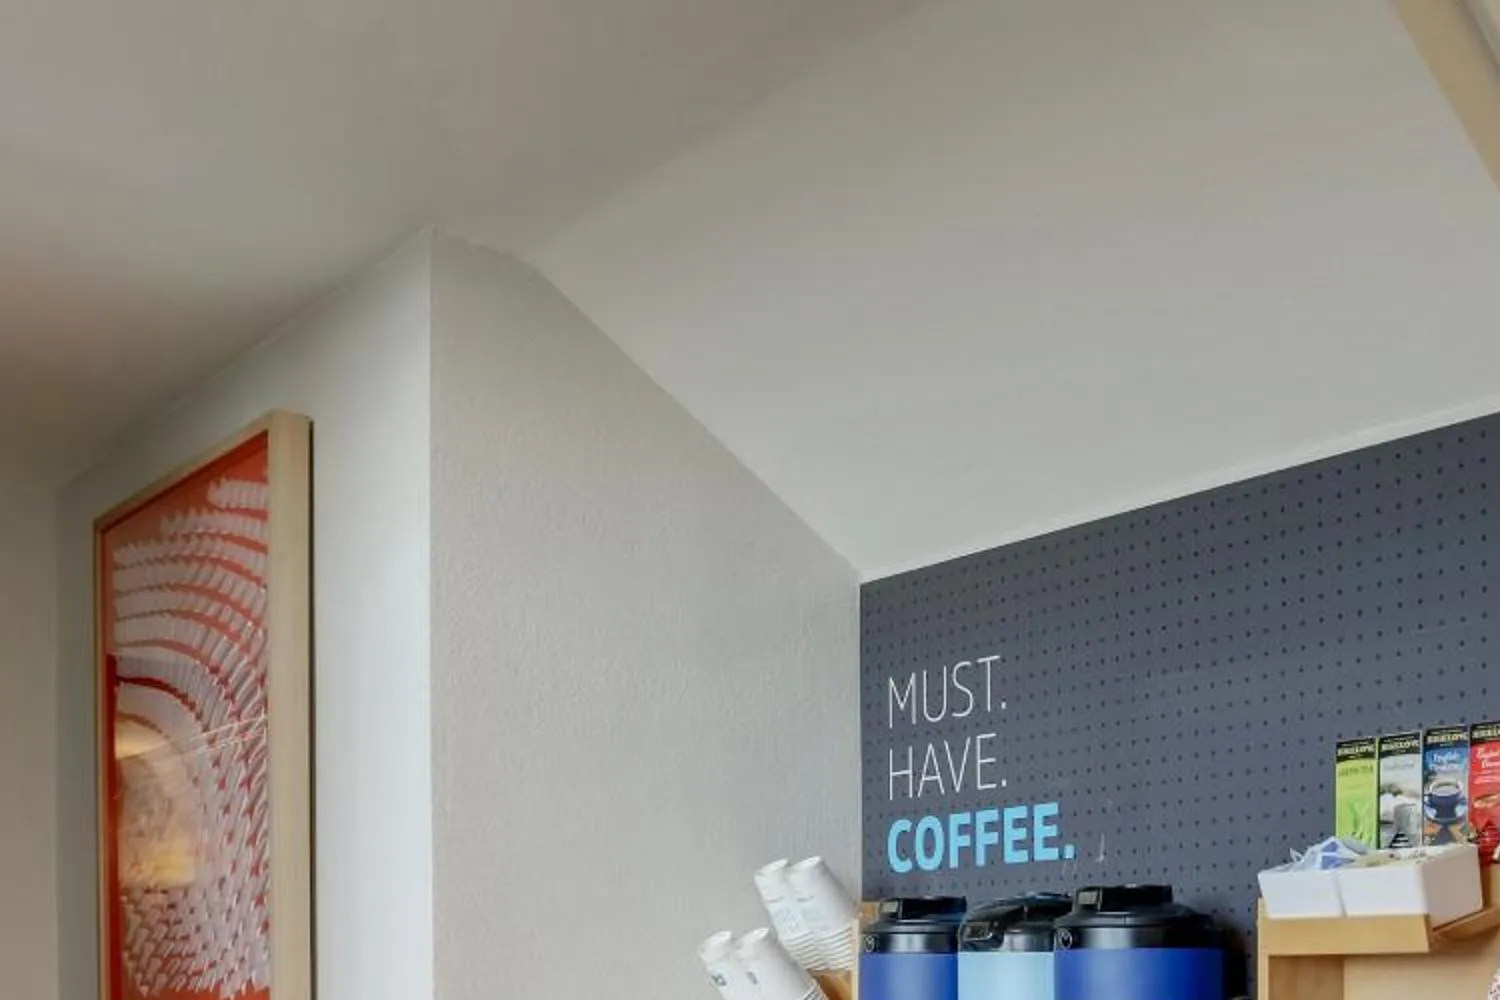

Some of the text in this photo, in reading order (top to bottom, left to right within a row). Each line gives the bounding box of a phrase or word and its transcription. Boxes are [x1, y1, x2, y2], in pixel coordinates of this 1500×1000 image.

[889, 655, 1006, 729] MUST.
[890, 733, 1007, 800] HAVE.
[888, 802, 1075, 873] COFFEE.
